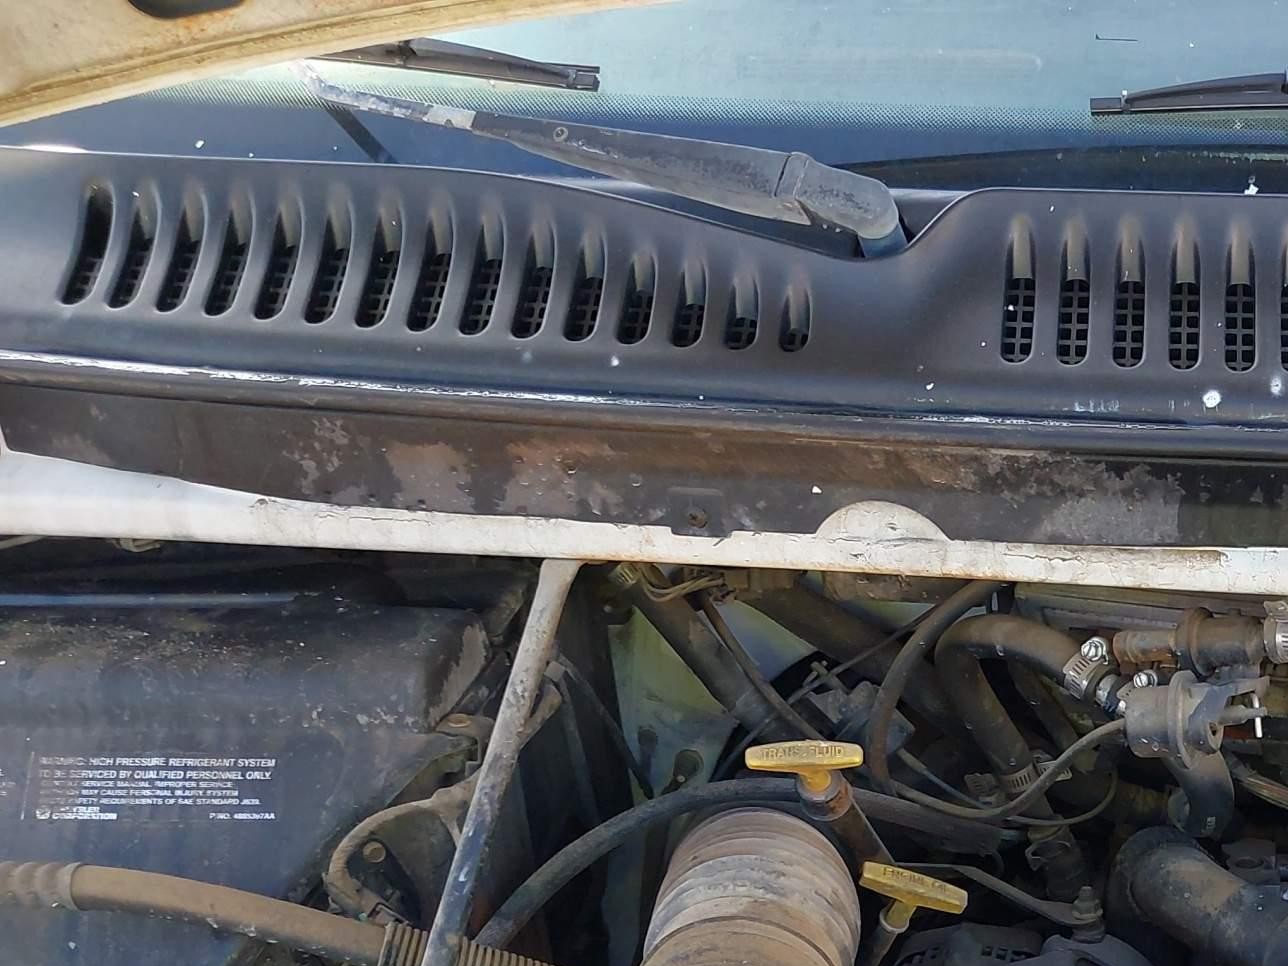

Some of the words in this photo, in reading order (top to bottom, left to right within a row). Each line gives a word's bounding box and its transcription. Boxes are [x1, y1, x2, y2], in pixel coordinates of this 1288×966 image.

[809, 746, 844, 758] FLUID
[89, 757, 114, 766] HIGH
[115, 757, 167, 767] PRESSURE
[168, 757, 236, 767] REFRIGERANT
[237, 758, 276, 767] SYSTEM
[69, 770, 117, 779] SERVICED
[119, 770, 132, 779] BY
[133, 770, 184, 779] QUALIFIED
[185, 771, 244, 780] PERSONNEL
